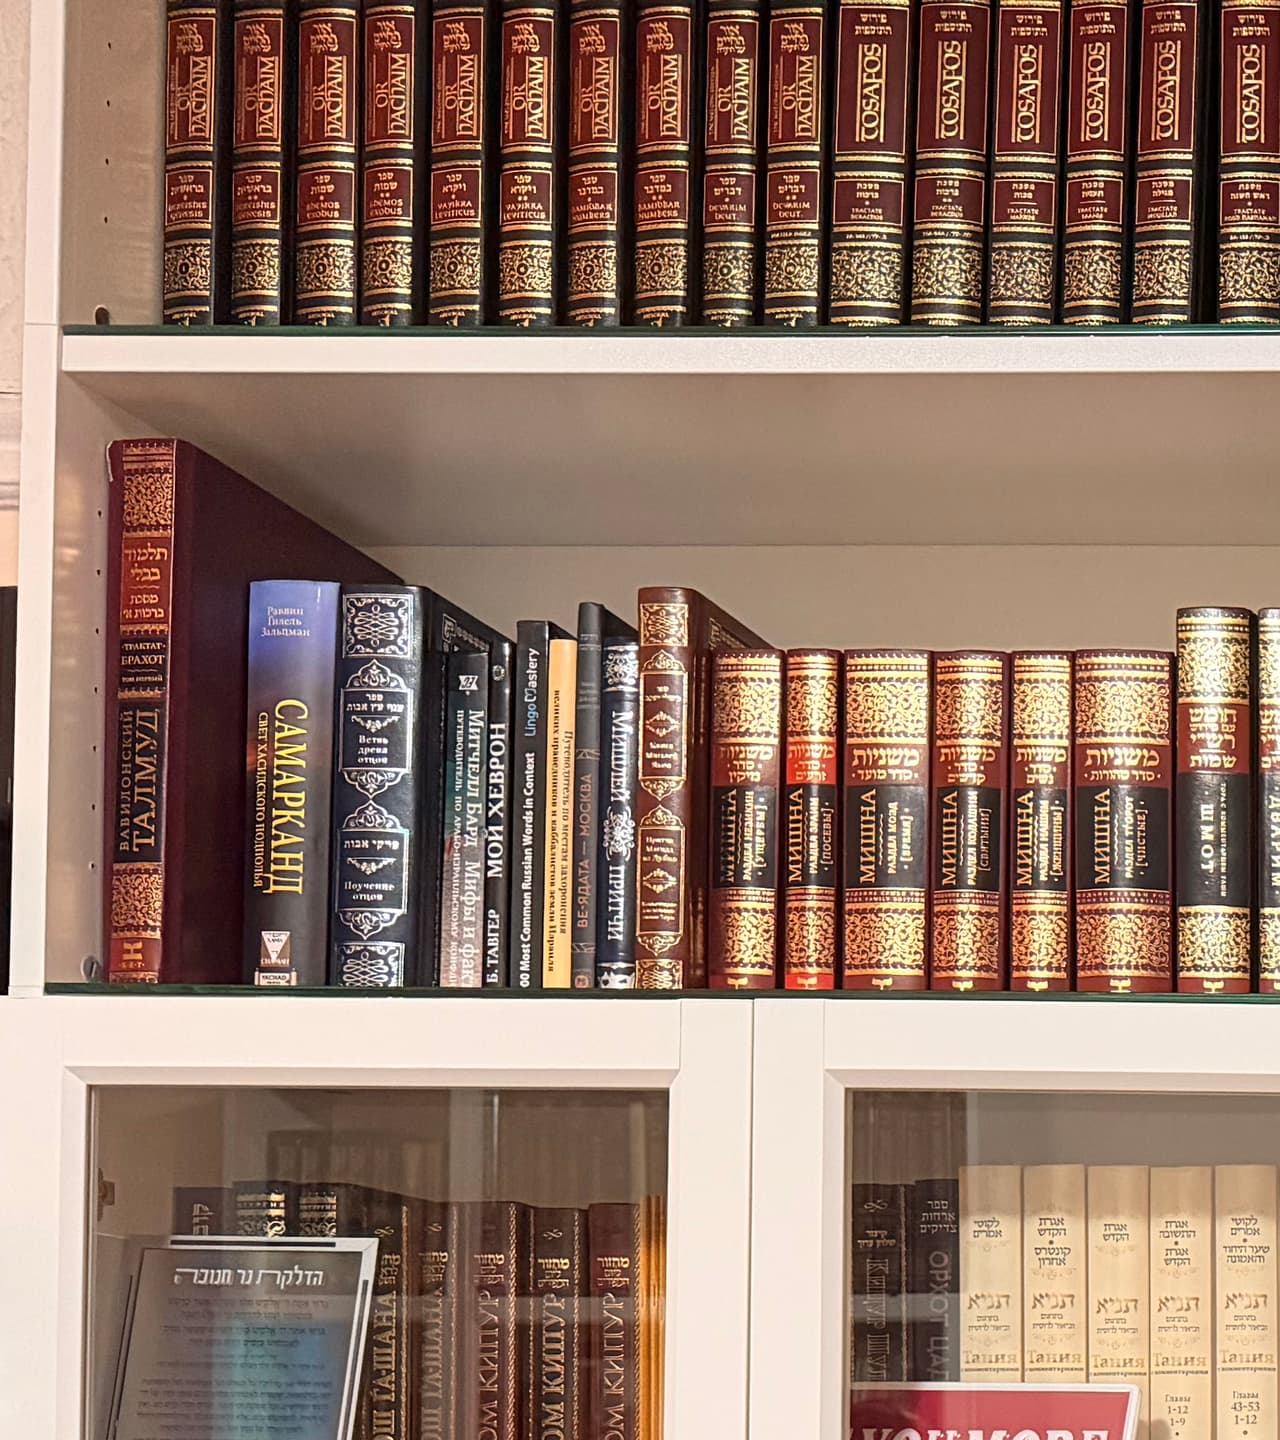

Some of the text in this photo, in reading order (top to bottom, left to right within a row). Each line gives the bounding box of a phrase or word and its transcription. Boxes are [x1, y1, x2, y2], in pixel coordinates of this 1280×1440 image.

[124, 545, 168, 564] תלמוד
[120, 654, 165, 666] БРАХОТ
[119, 709, 131, 852] ВАВИЛОНСКИЙ
[133, 708, 158, 852] ТАЛМУД
[263, 699, 309, 895] САМАРКАНД
[491, 723, 507, 823] ХЕВРОН
[489, 829, 505, 878] МОЙ
[520, 752, 537, 971] Most Common Russian Words in Context
[859, 788, 875, 884] МИШНА
[1095, 788, 1110, 884] МИШНА
